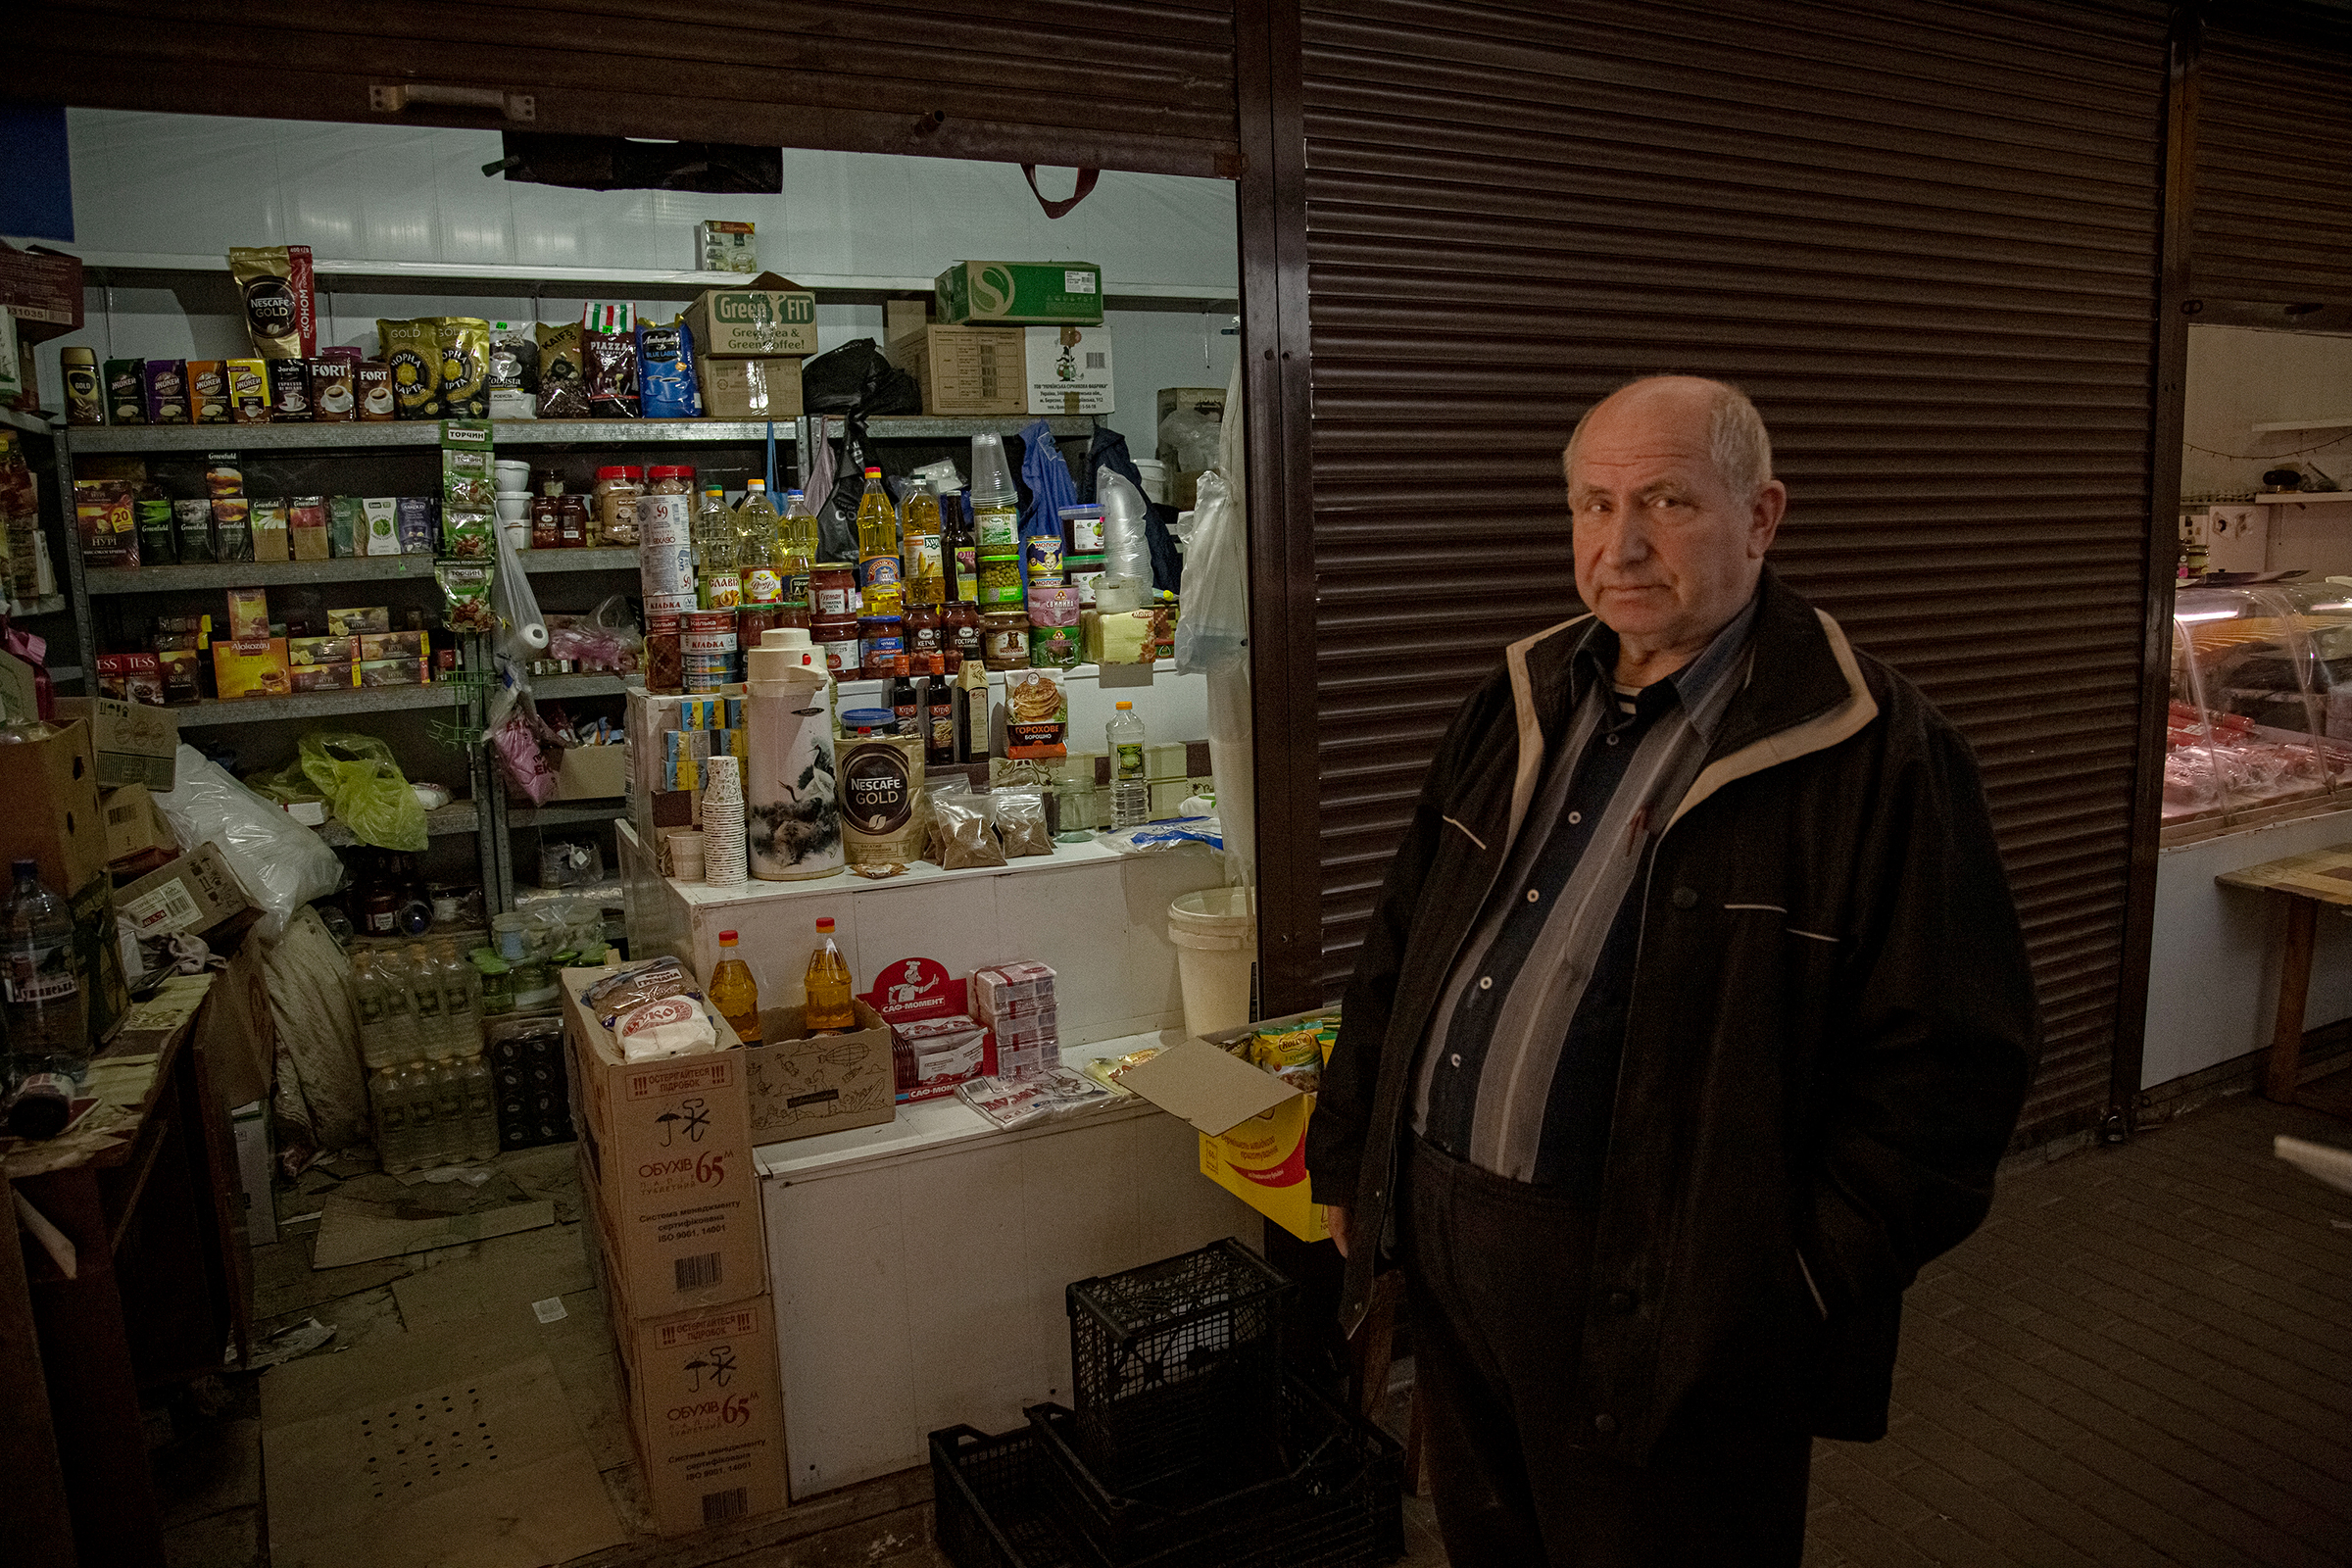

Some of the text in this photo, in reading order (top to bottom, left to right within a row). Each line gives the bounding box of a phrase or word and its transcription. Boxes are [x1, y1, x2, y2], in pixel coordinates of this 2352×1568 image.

[255, 307, 288, 318] GOLD
[720, 297, 810, 320] Green FIT
[390, 328, 421, 338] GOLD
[732, 327, 767, 338] Gre
[790, 327, 801, 337] &
[590, 342, 626, 351] PIAZZA
[441, 350, 467, 365] ОРНА
[312, 365, 347, 377] FORT
[360, 370, 388, 381] FORT
[74, 380, 91, 390] GOLD
[449, 431, 484, 440] ТОРЧИН
[253, 501, 279, 510] Greenfield
[113, 511, 128, 523] 20
[835, 510, 858, 521] CO
[219, 521, 245, 530] Greenfield
[92, 538, 118, 547] НУРІ
[794, 587, 808, 598] ДА
[231, 640, 270, 651] Alokozay
[955, 637, 978, 646] ГОСТРИЙ
[129, 657, 156, 668] TESS
[1015, 725, 1059, 735] ГОРОХОВЕ
[856, 792, 899, 806] GOLD
[638, 972, 680, 987] ГРЕЧАНА
[882, 997, 945, 1013] САФ-МОМЕНТ
[627, 1004, 685, 1033] ЦУКОР
[649, 1067, 710, 1084] ОСТЕРІГАЙТЕСЯ
[661, 1080, 701, 1093] ПІДРОБОК
[910, 1085, 956, 1099] САФ-МОМ
[638, 1158, 693, 1178] ОБУХІВ
[695, 1151, 725, 1189] 65
[639, 1200, 741, 1222] Система менеджменту
[658, 1214, 725, 1232] сертифікована
[658, 1224, 725, 1243] ISO 9001, 14001
[676, 1316, 735, 1333] ОСТЕРІГАЙТЕСЯ
[687, 1327, 726, 1341] ПІДРОБОК
[666, 1400, 720, 1421] ОБУХІВ
[722, 1392, 750, 1429] 65
[668, 1439, 766, 1464] Система менеджменту
[686, 1453, 751, 1471] сертифікована
[728, 1461, 752, 1472] 14001
